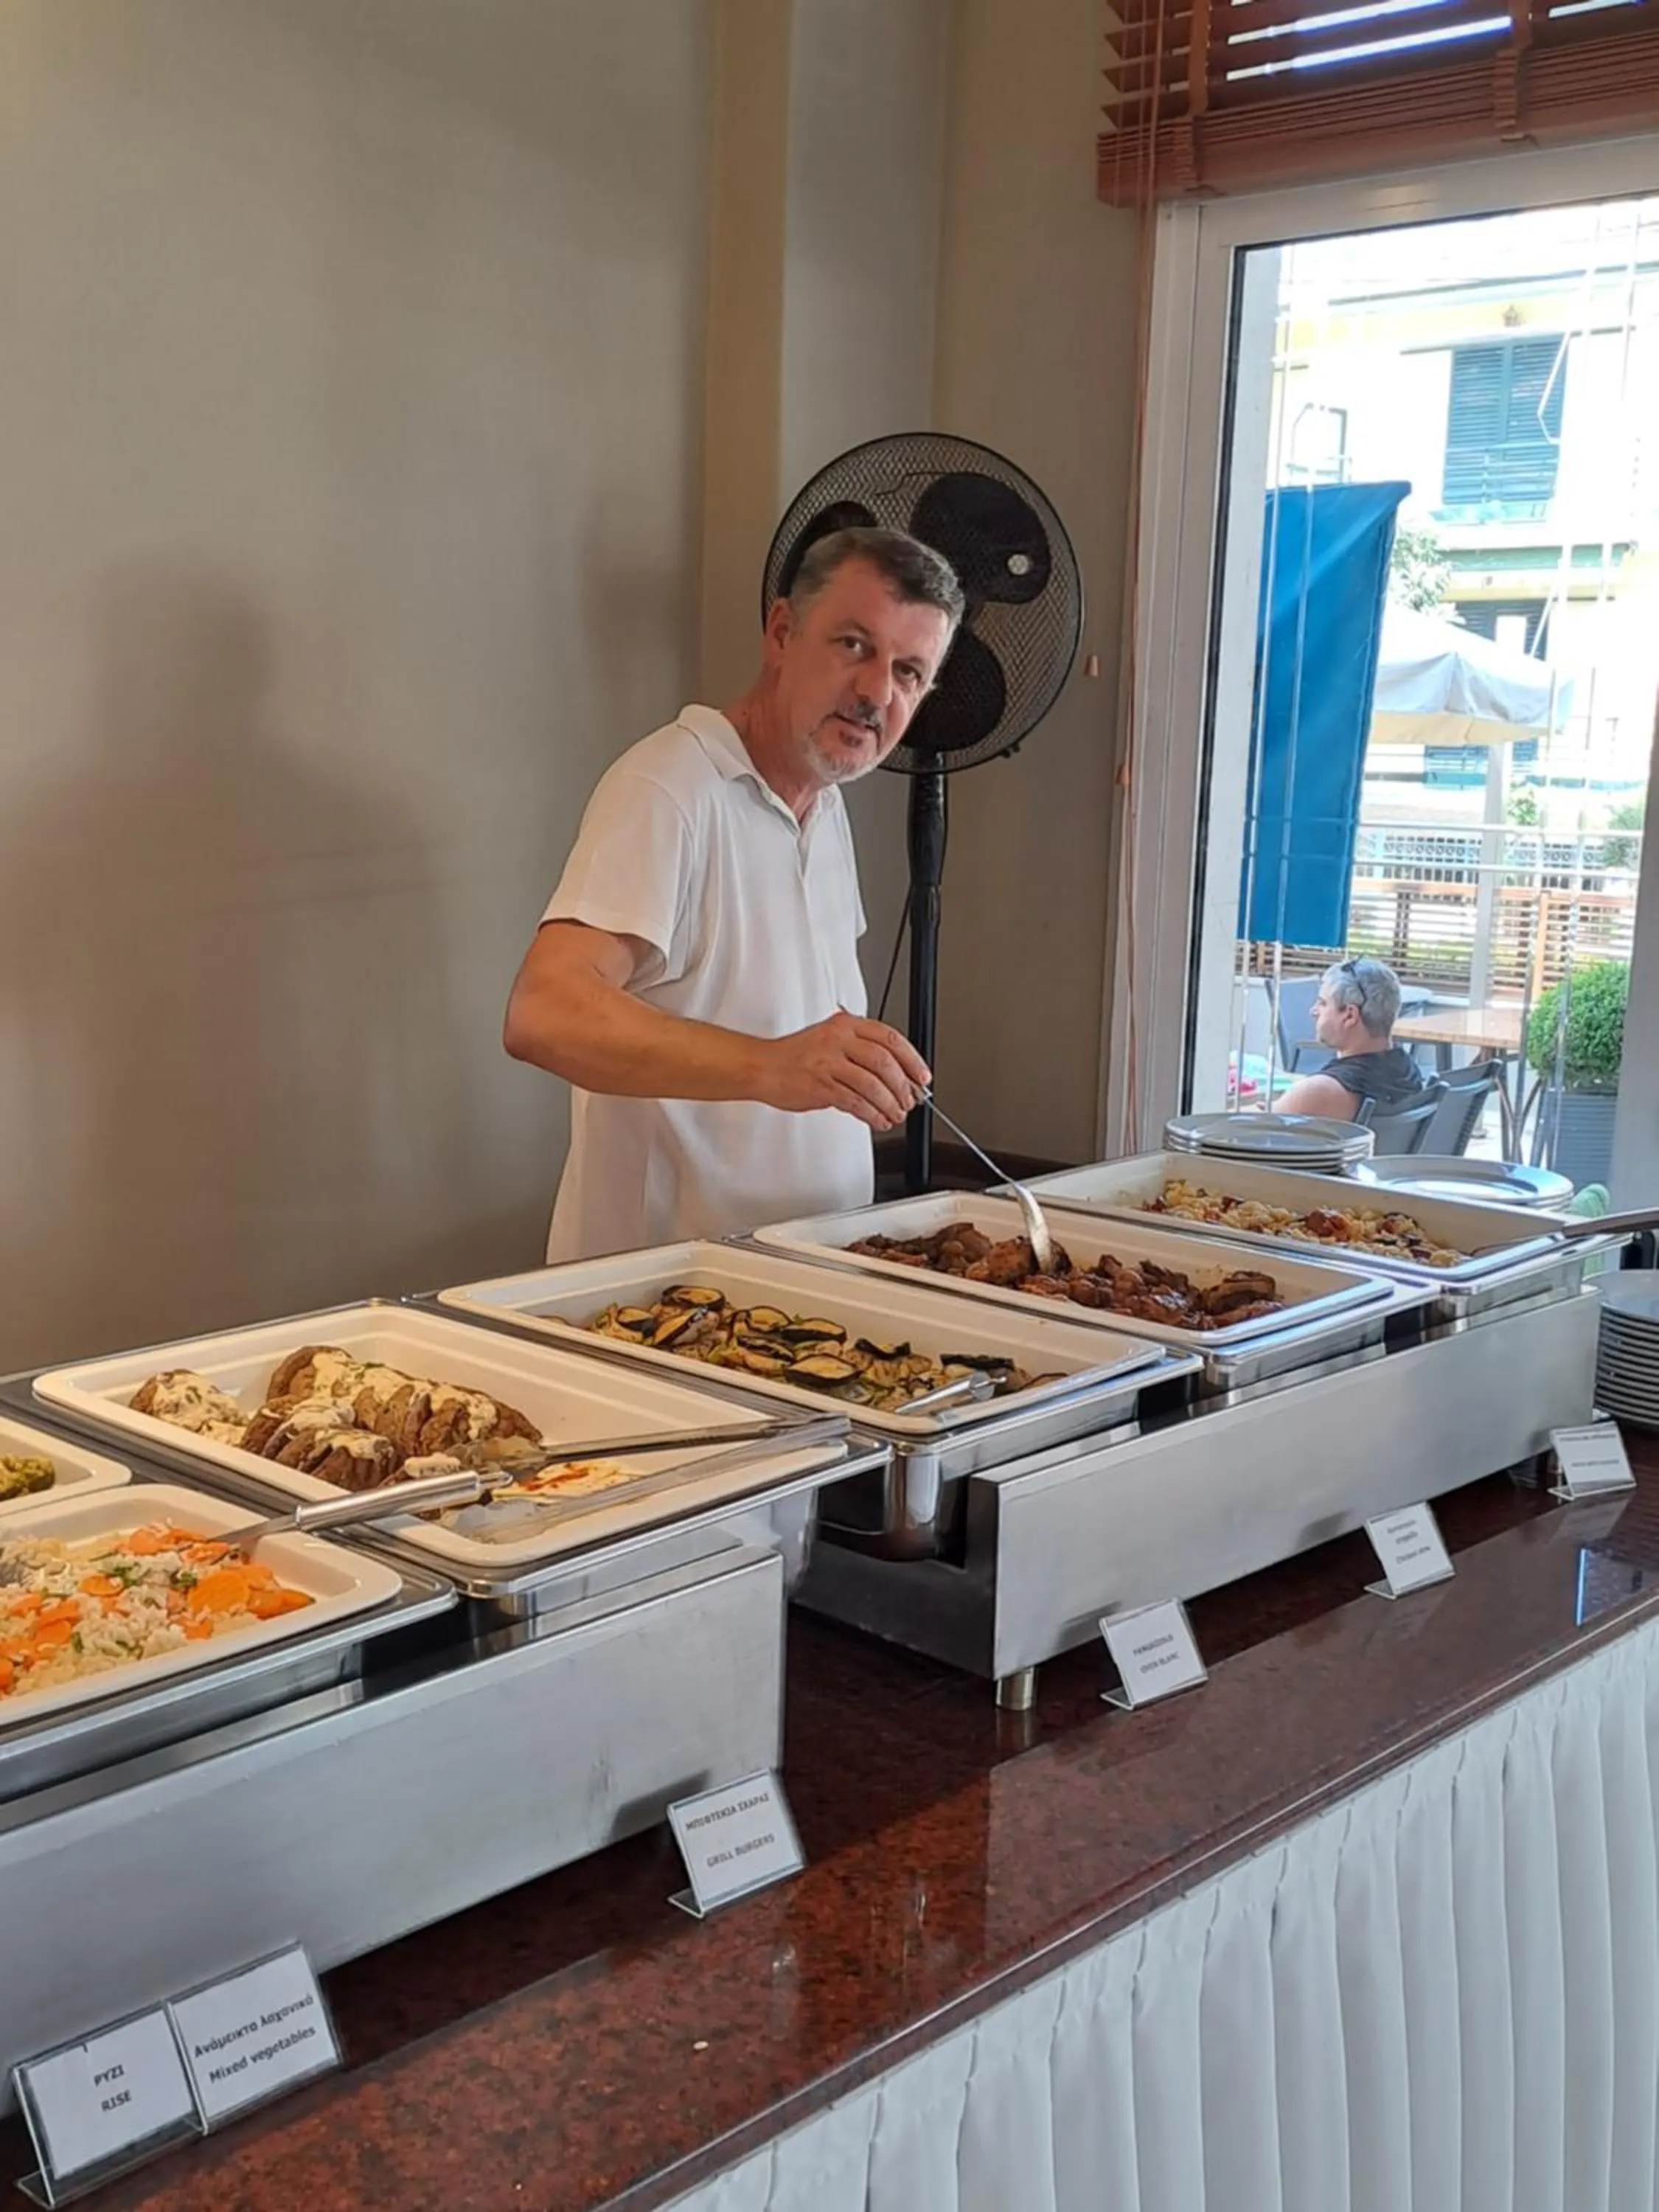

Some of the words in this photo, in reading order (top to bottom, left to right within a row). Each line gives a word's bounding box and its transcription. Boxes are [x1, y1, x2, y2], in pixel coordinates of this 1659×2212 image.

[209, 2056, 248, 2084] Mixed
[251, 2025, 316, 2065] vegetables
[101, 2090, 132, 2112] RISE
